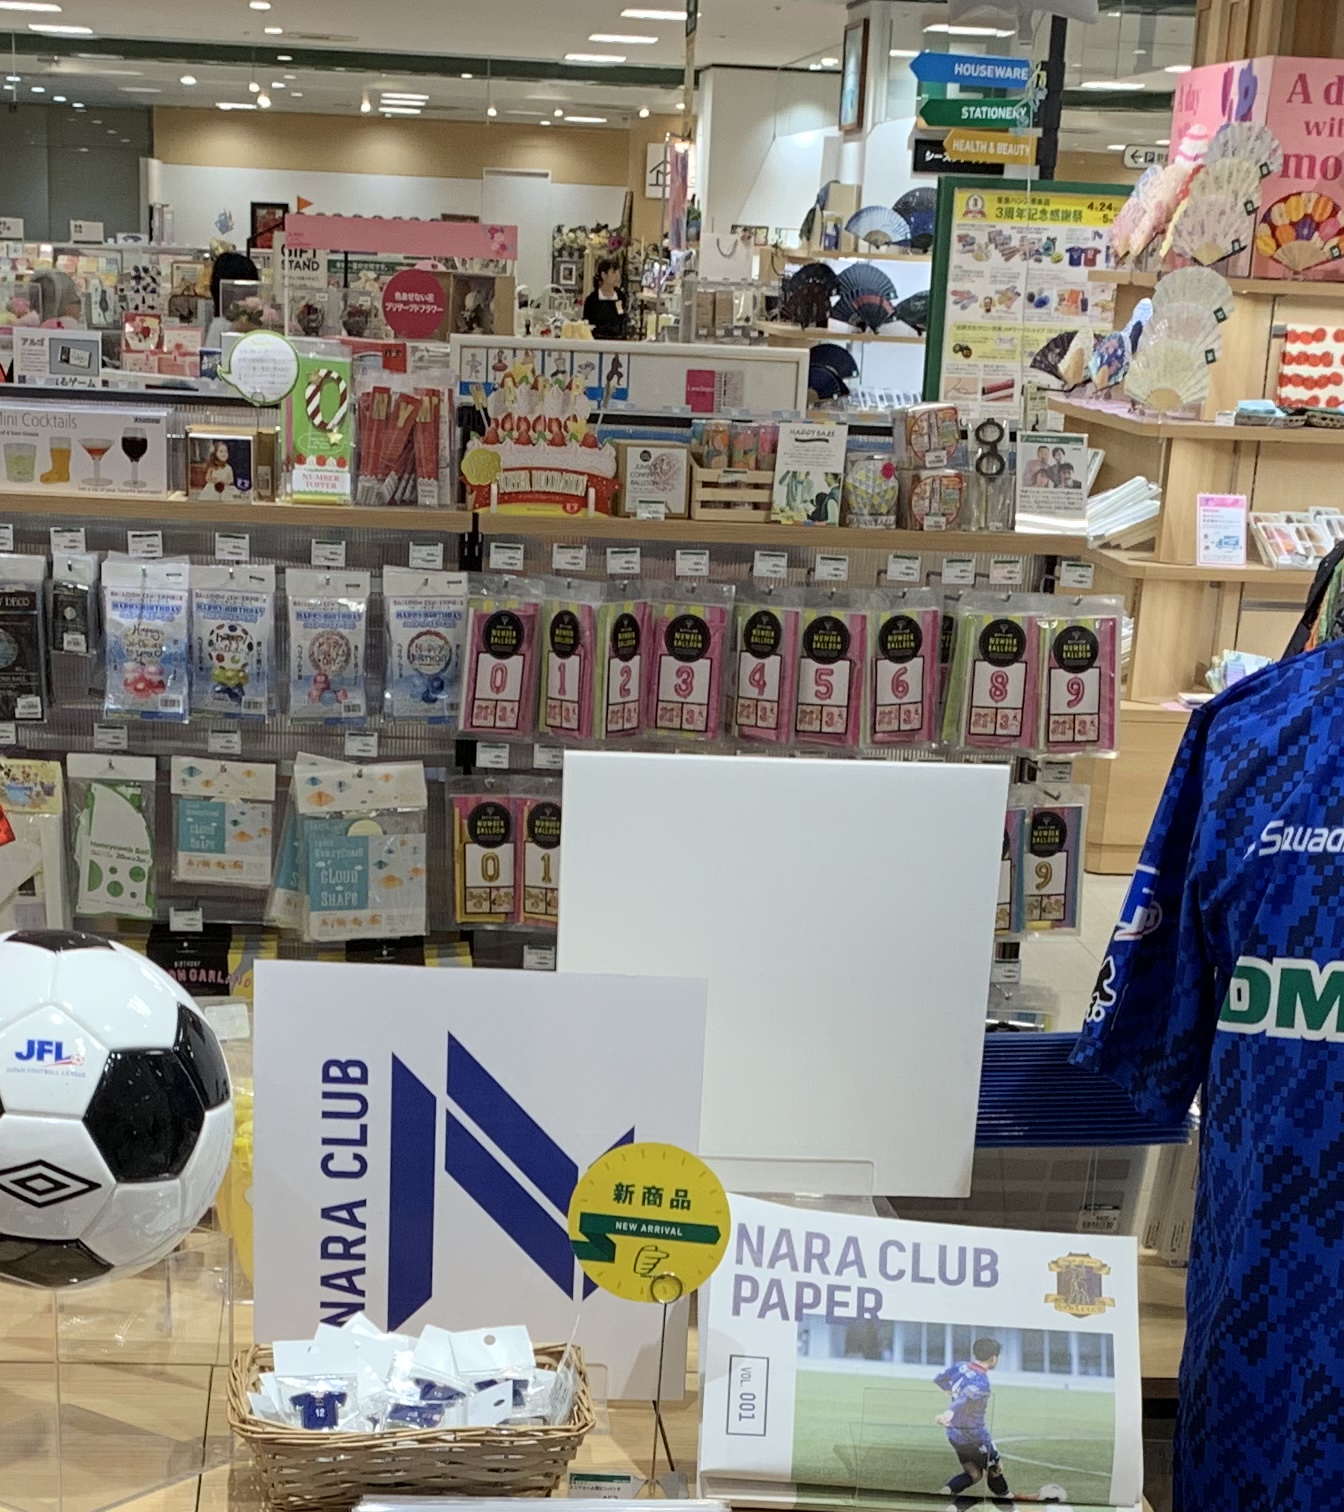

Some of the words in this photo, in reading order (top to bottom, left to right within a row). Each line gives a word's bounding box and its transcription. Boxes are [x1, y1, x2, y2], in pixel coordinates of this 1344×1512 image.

[955, 63, 1029, 80] HOUSEWARE
[1286, 73, 1313, 105] A
[961, 106, 1027, 120] STATIONERY
[953, 139, 986, 154] HEALTH
[988, 141, 995, 154] &
[998, 141, 1031, 157] BEAUTY
[281, 258, 320, 272] STAND
[22, 412, 78, 429] Cocktails
[302, 472, 340, 483] NUMBER
[5, 596, 30, 607] DECO
[490, 662, 508, 694] 0
[557, 662, 566, 696] 1
[619, 665, 633, 698] 2
[674, 665, 696, 699] 3
[748, 661, 767, 696] 4
[814, 668, 834, 700] 5
[891, 667, 909, 699] 6
[989, 670, 1009, 703] 8
[1067, 676, 1085, 709] 9
[481, 851, 500, 882] 0
[15, 1038, 72, 1062] JFL
[320, 1057, 369, 1179] CLUB
[613, 1181, 693, 1212] 新商品
[615, 1220, 637, 1233] NEW
[639, 1221, 683, 1237] ARRIVAL
[320, 1198, 368, 1327] NARA
[735, 1222, 868, 1279] NARA
[878, 1238, 1000, 1290] CLUB
[731, 1273, 884, 1326] PAPER
[739, 1365, 752, 1388] VOL.
[738, 1390, 756, 1422] 001
